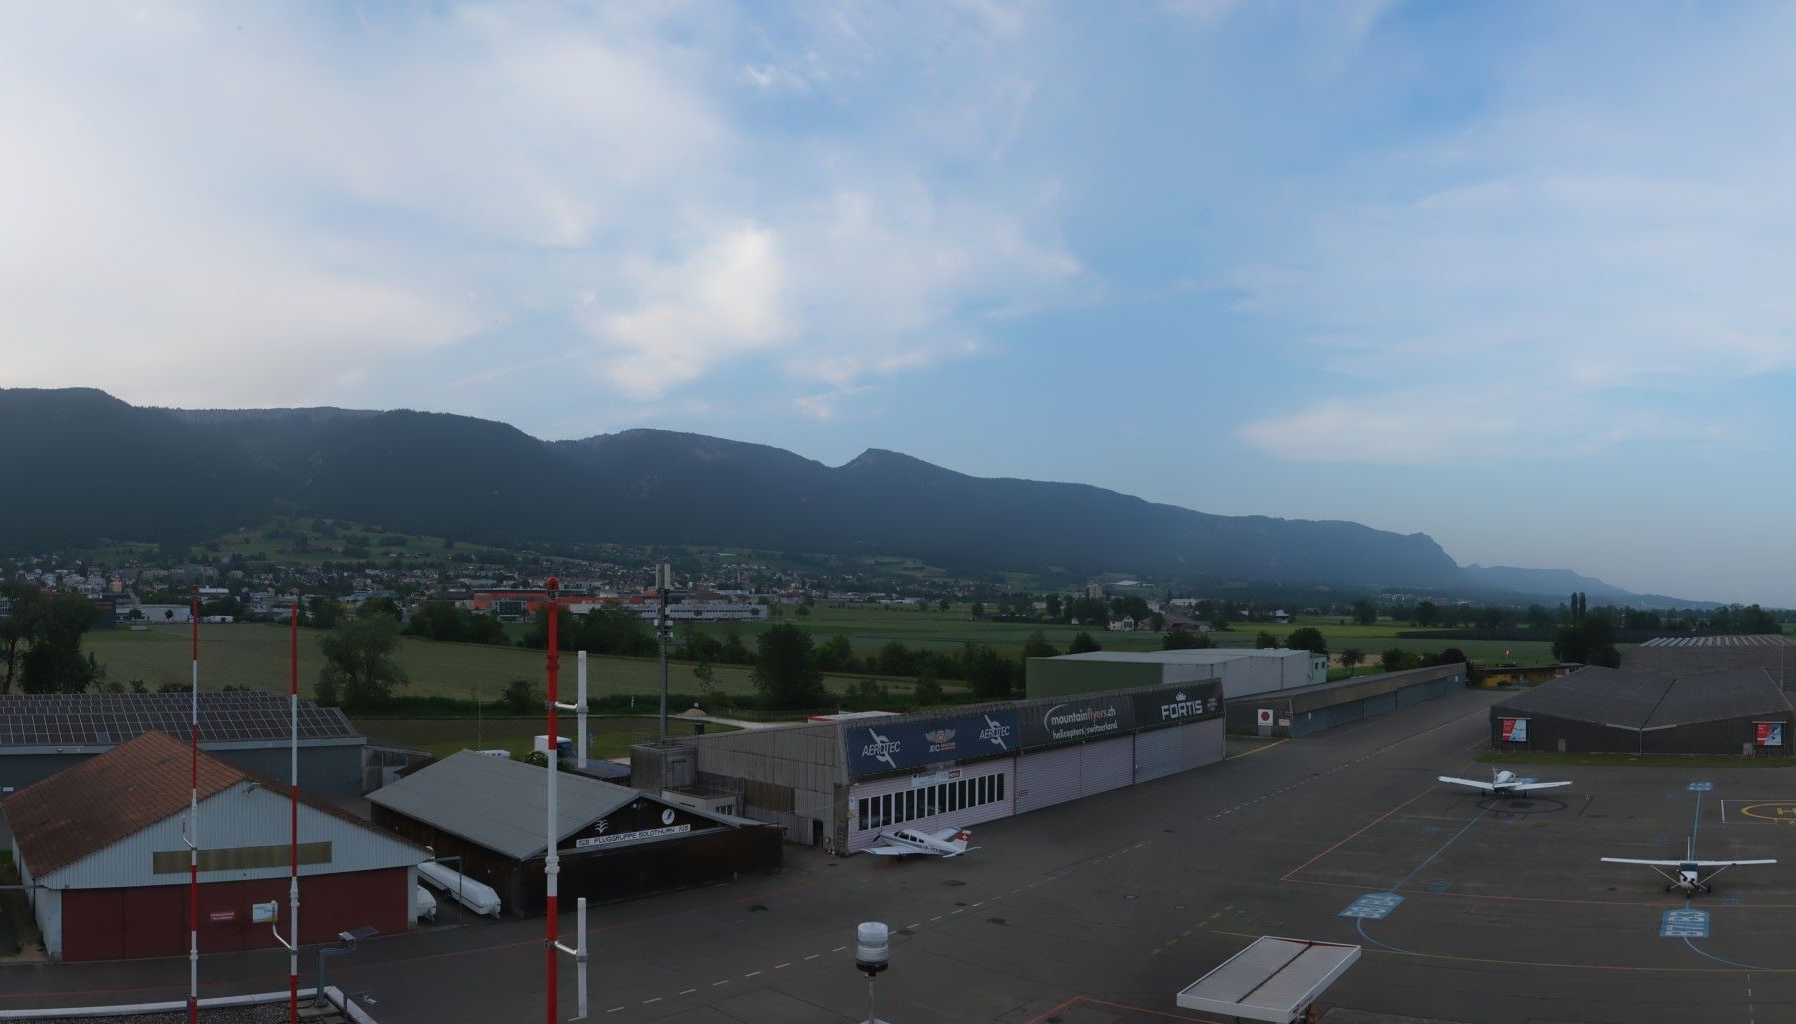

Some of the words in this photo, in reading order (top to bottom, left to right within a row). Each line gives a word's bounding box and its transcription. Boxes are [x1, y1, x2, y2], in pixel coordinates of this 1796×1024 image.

[1051, 705, 1116, 725] mountainflyers.ch
[1161, 700, 1203, 720] FORTIS
[979, 725, 1010, 740] AEROTEC
[862, 740, 902, 757] AEROTEC
